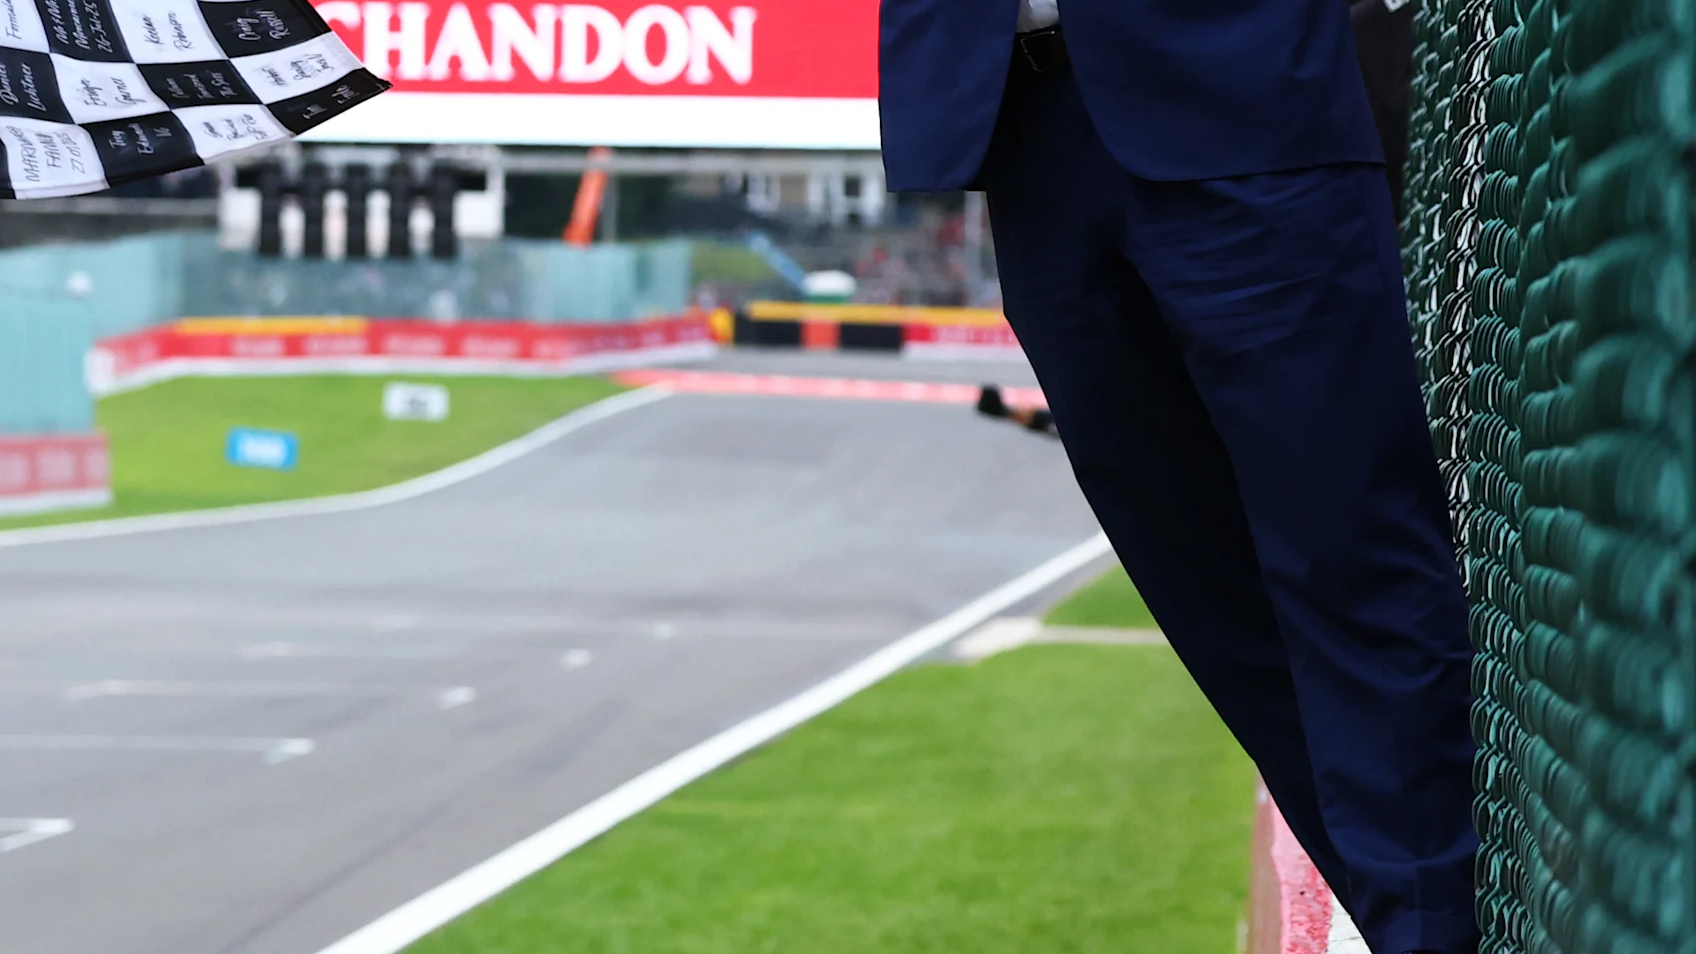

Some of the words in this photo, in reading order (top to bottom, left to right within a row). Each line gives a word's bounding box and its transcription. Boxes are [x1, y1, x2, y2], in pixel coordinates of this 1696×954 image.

[167, 10, 193, 51] Robinson
[235, 16, 262, 41] Craig
[257, 9, 290, 39] Russell
[20, 62, 47, 112] Lichtner
